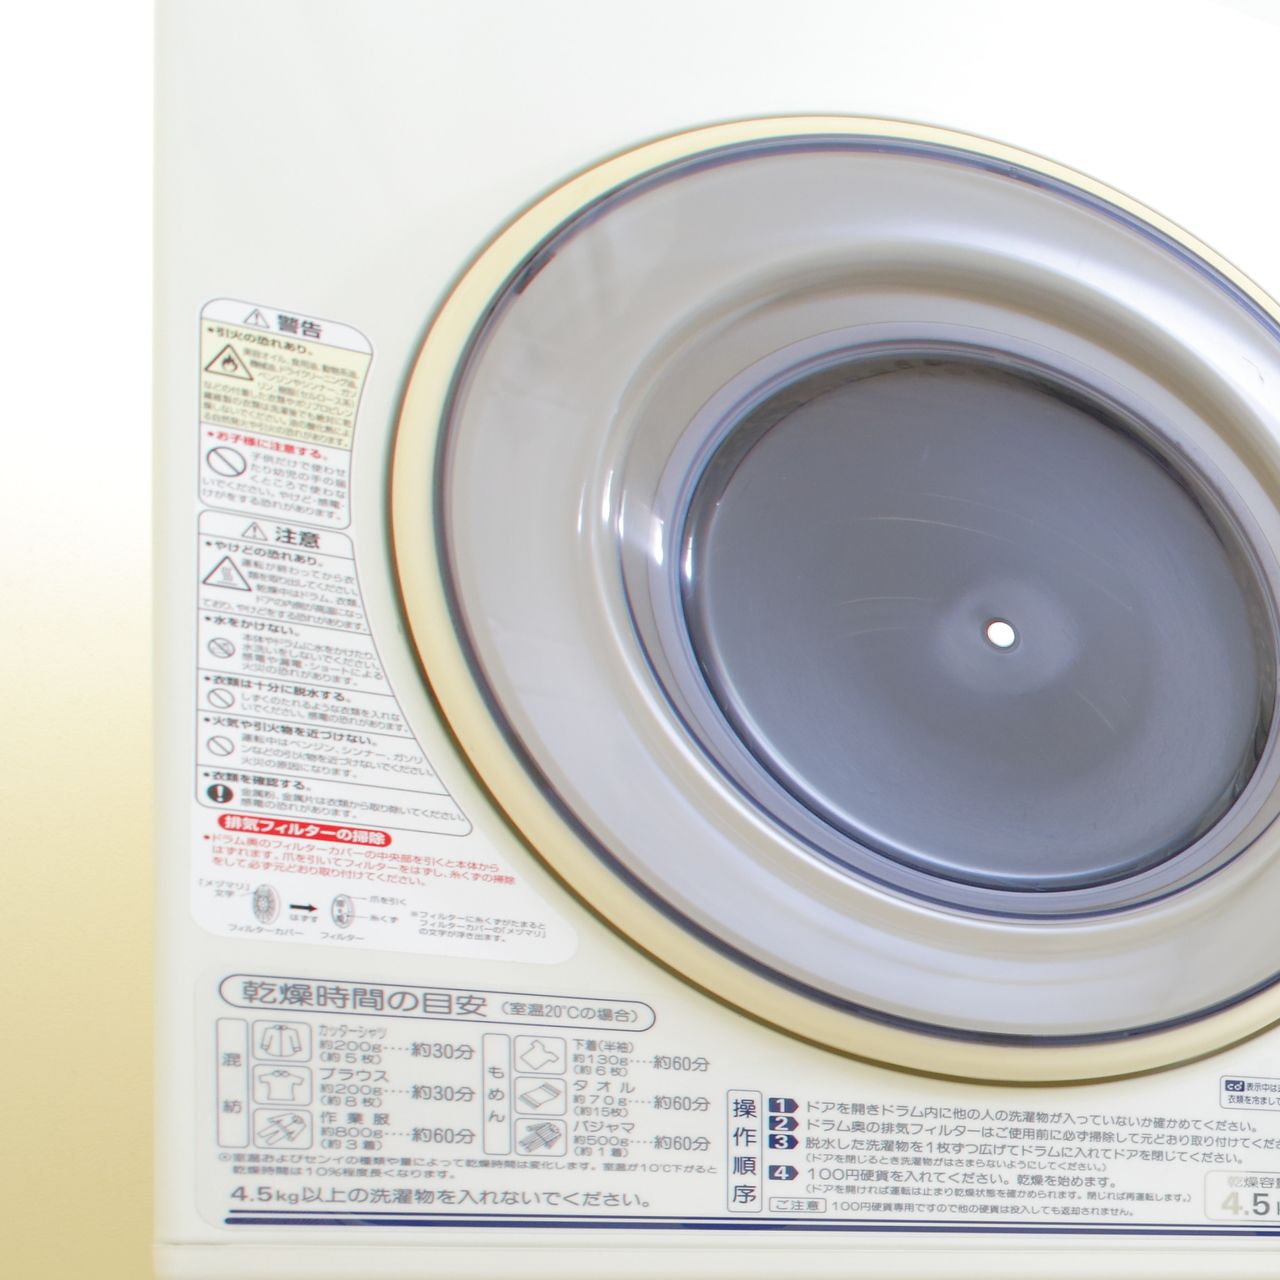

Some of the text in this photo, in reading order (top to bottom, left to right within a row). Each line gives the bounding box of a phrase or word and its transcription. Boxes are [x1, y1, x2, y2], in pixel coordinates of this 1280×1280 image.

[277, 313, 322, 339] 警告
[275, 525, 320, 549] 注意
[225, 815, 386, 845] 排気フィルターの掃除
[242, 980, 488, 1018] 乾燥時間の目安
[411, 1042, 475, 1061] 約30分
[653, 1055, 711, 1072] 約60分
[319, 1068, 389, 1083] ブラウス
[411, 1085, 476, 1103] 約30分
[653, 1096, 711, 1112] 約60分
[775, 1098, 786, 1113] 1
[774, 1116, 790, 1131] 2
[411, 1128, 476, 1145] 約60分
[653, 1135, 711, 1152] 約60分
[774, 1135, 789, 1149] 3
[732, 1098, 758, 1204] 操作順序
[773, 1165, 789, 1179] 4
[776, 1199, 819, 1211] ご注意
